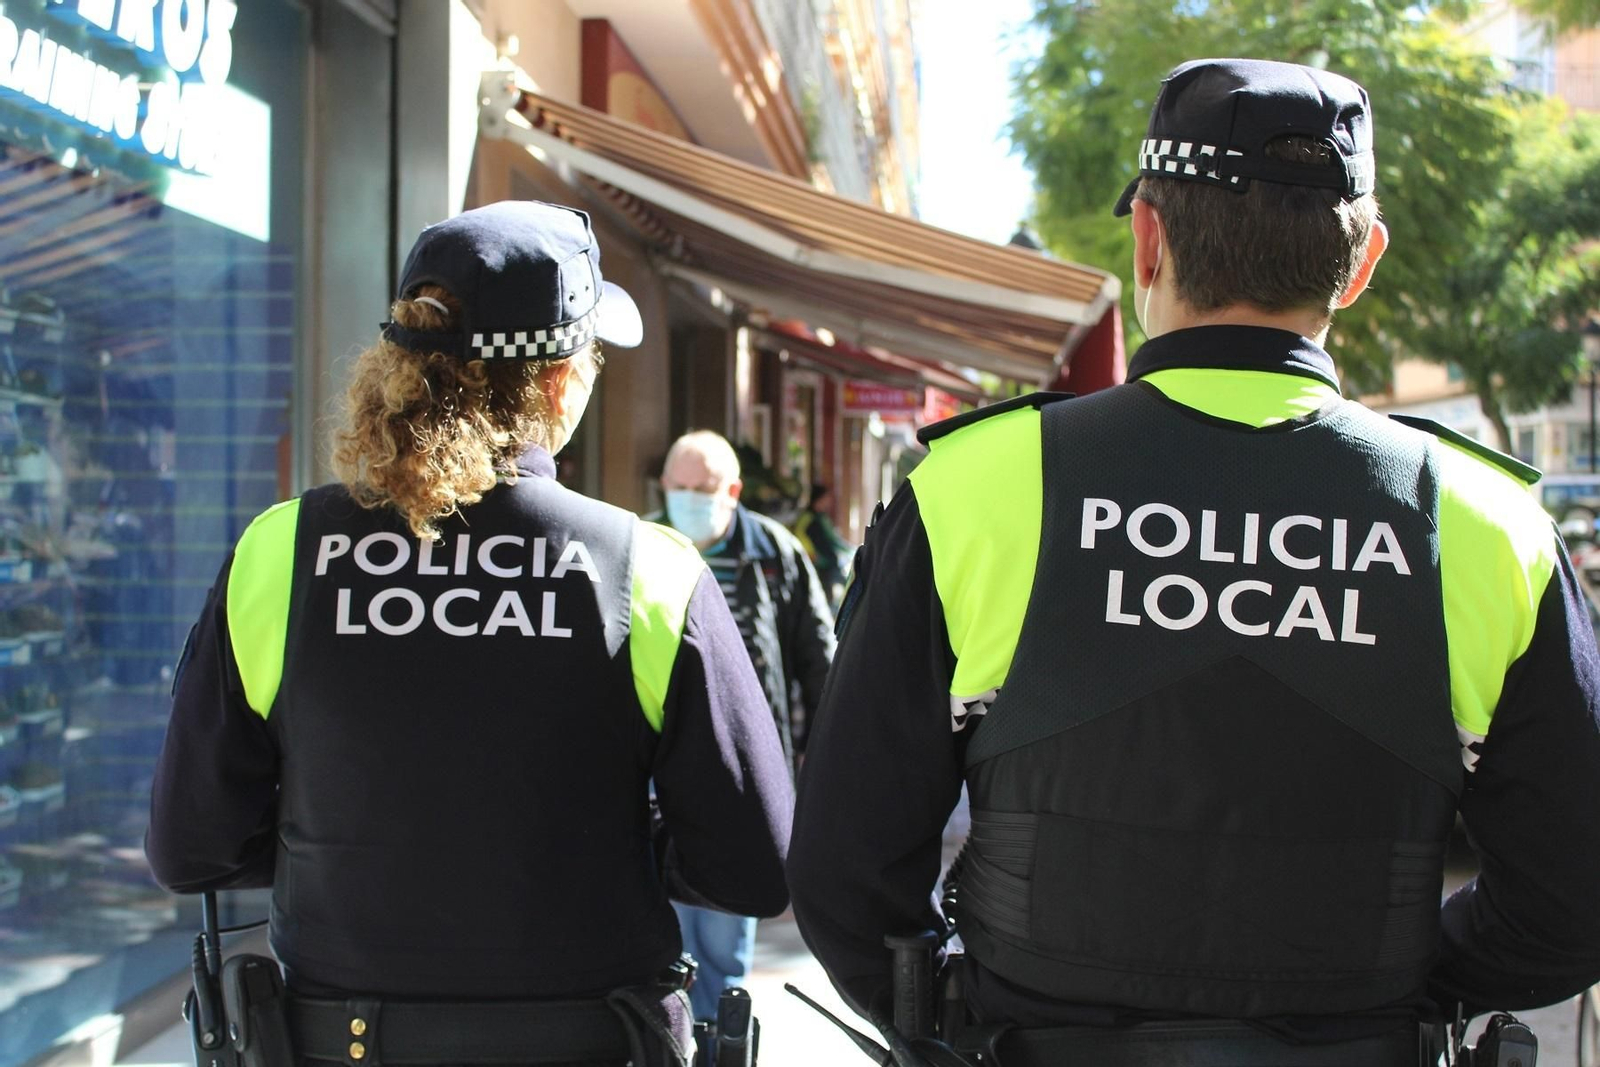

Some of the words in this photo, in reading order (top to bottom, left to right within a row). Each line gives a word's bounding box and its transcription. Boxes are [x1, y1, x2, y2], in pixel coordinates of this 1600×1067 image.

[315, 532, 602, 583] POLICIA
[1081, 498, 1412, 575] POLICIA
[336, 588, 572, 638] LOCAL
[1105, 570, 1376, 645] LOCAL
